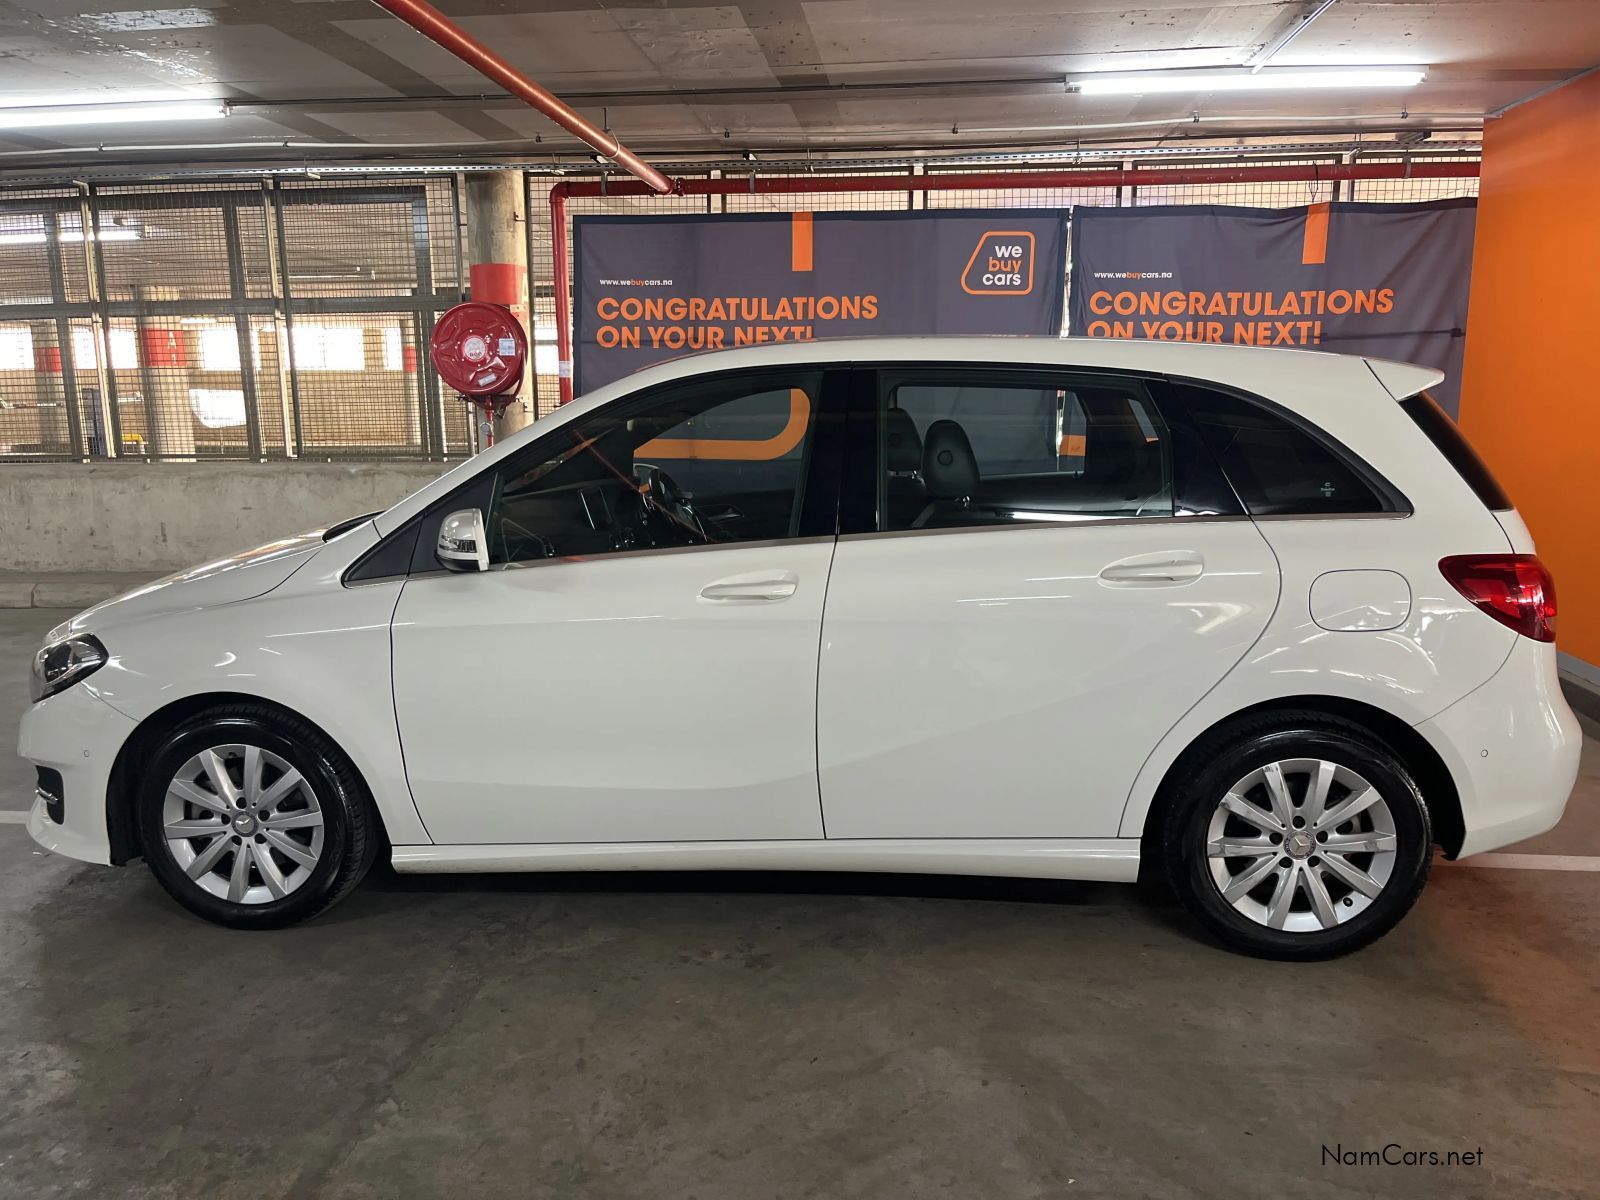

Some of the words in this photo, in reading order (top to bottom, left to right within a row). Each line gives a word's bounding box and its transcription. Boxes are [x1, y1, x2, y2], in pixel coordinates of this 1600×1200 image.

[994, 245, 1023, 258] we
[988, 256, 1022, 274] buy
[599, 278, 673, 287] www.webuycars.na
[982, 273, 1022, 286] cars
[1093, 271, 1173, 280] www.webuycars.na
[596, 295, 879, 322] CONGRATULATIONS
[1089, 288, 1394, 317] CONGRATULATIONS
[167, 331, 177, 349] A
[596, 325, 641, 349] ON
[647, 325, 725, 350] YOUR
[1087, 320, 1133, 338] ON
[1141, 321, 1225, 344] YOUR
[1233, 320, 1322, 346] NEXT!
